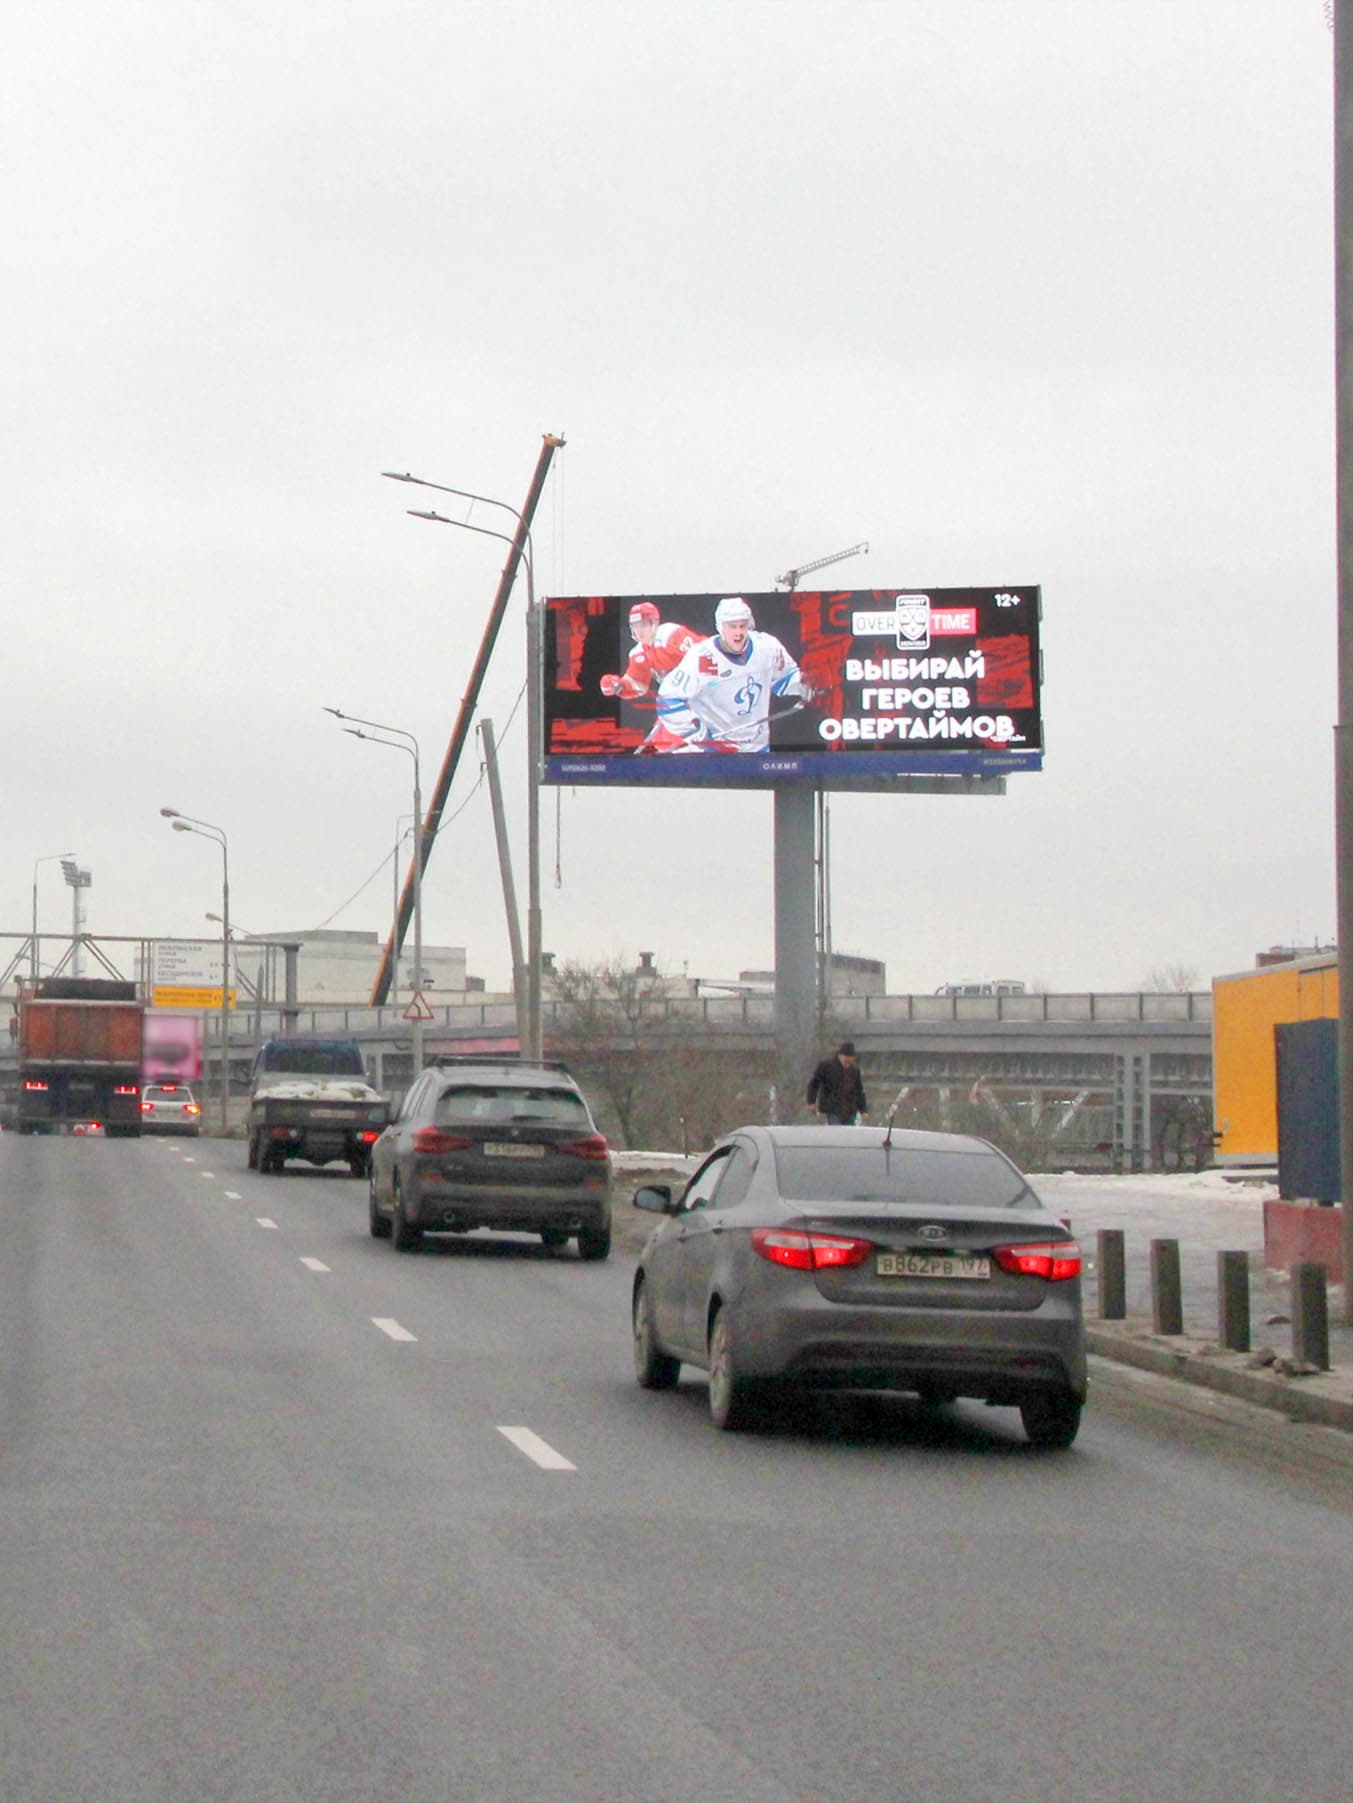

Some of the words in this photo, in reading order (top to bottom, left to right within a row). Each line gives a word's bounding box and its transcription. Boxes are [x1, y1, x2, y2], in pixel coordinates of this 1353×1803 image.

[994, 593, 1021, 608] 12+
[856, 614, 895, 631] OVER
[931, 613, 970, 630] TIME
[846, 650, 985, 681] ВЫБИРАЙ
[862, 687, 970, 710] ГЕРОЕВ
[819, 710, 1015, 741] ОВЕРТАЙМОВ
